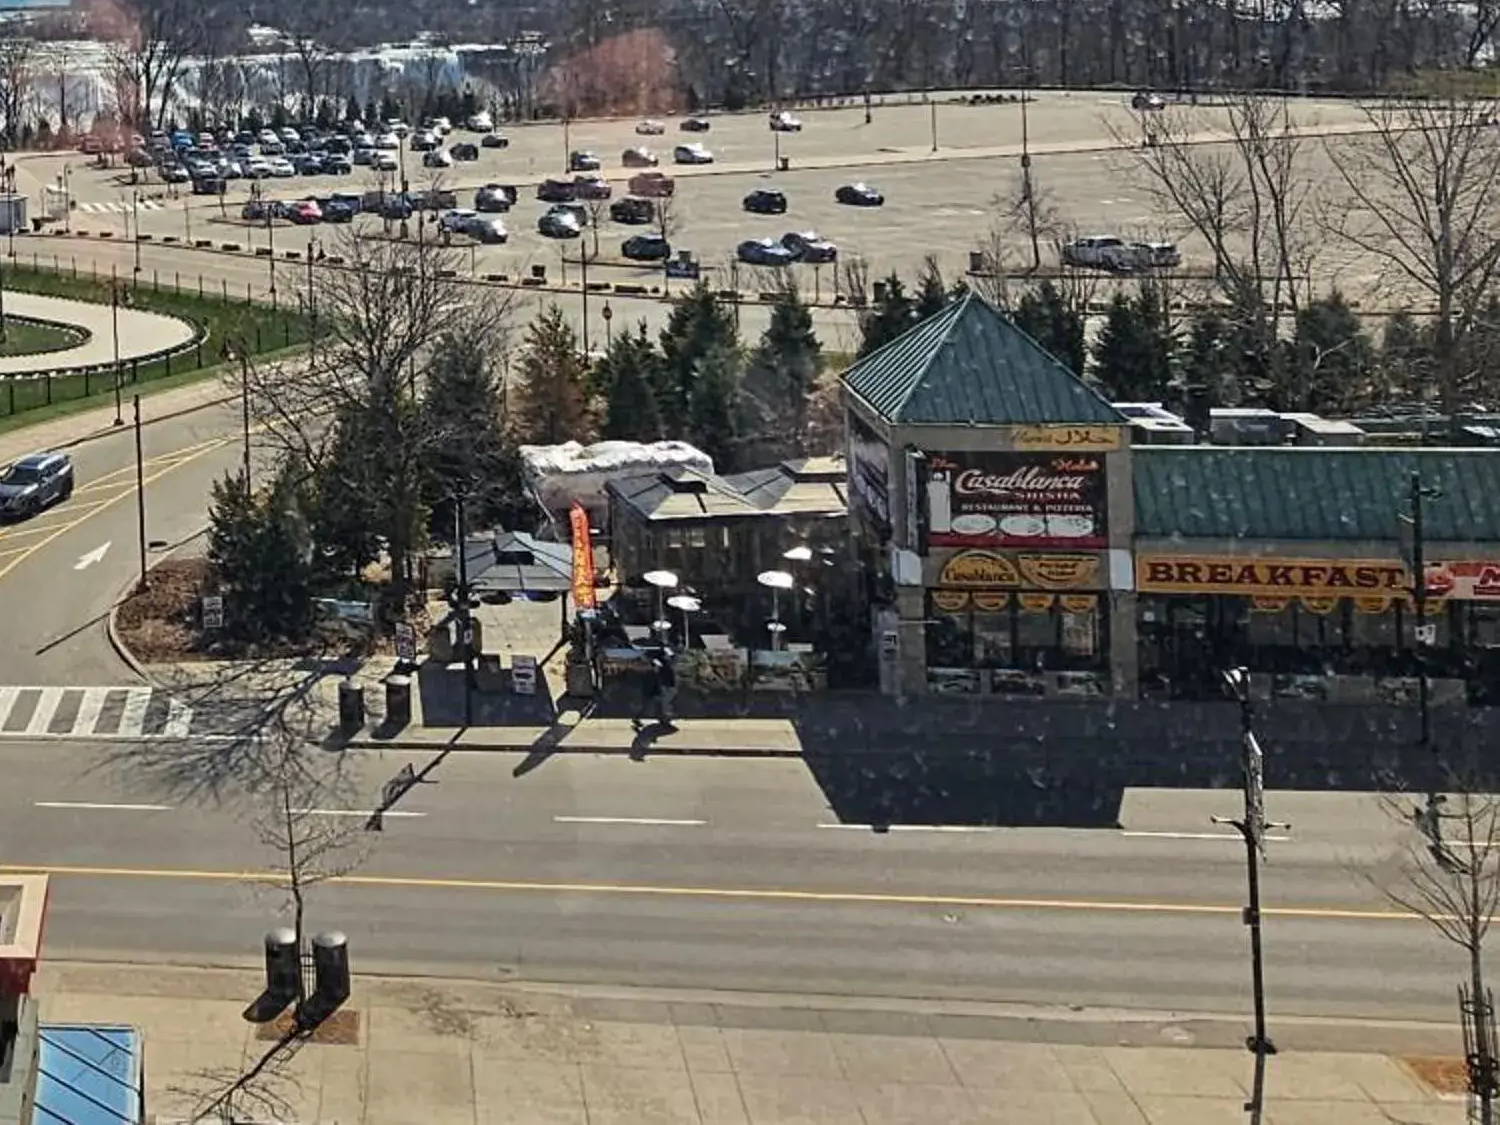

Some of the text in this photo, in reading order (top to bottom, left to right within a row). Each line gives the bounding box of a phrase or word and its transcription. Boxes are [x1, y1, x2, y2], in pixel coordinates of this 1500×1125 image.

[954, 466, 1085, 495] Casablanca
[1012, 491, 1081, 500] SHISHA
[960, 502, 1030, 512] RESTAURANT
[1045, 503, 1094, 513] PIZZERIA
[1146, 561, 1406, 589] BREAKFAST
